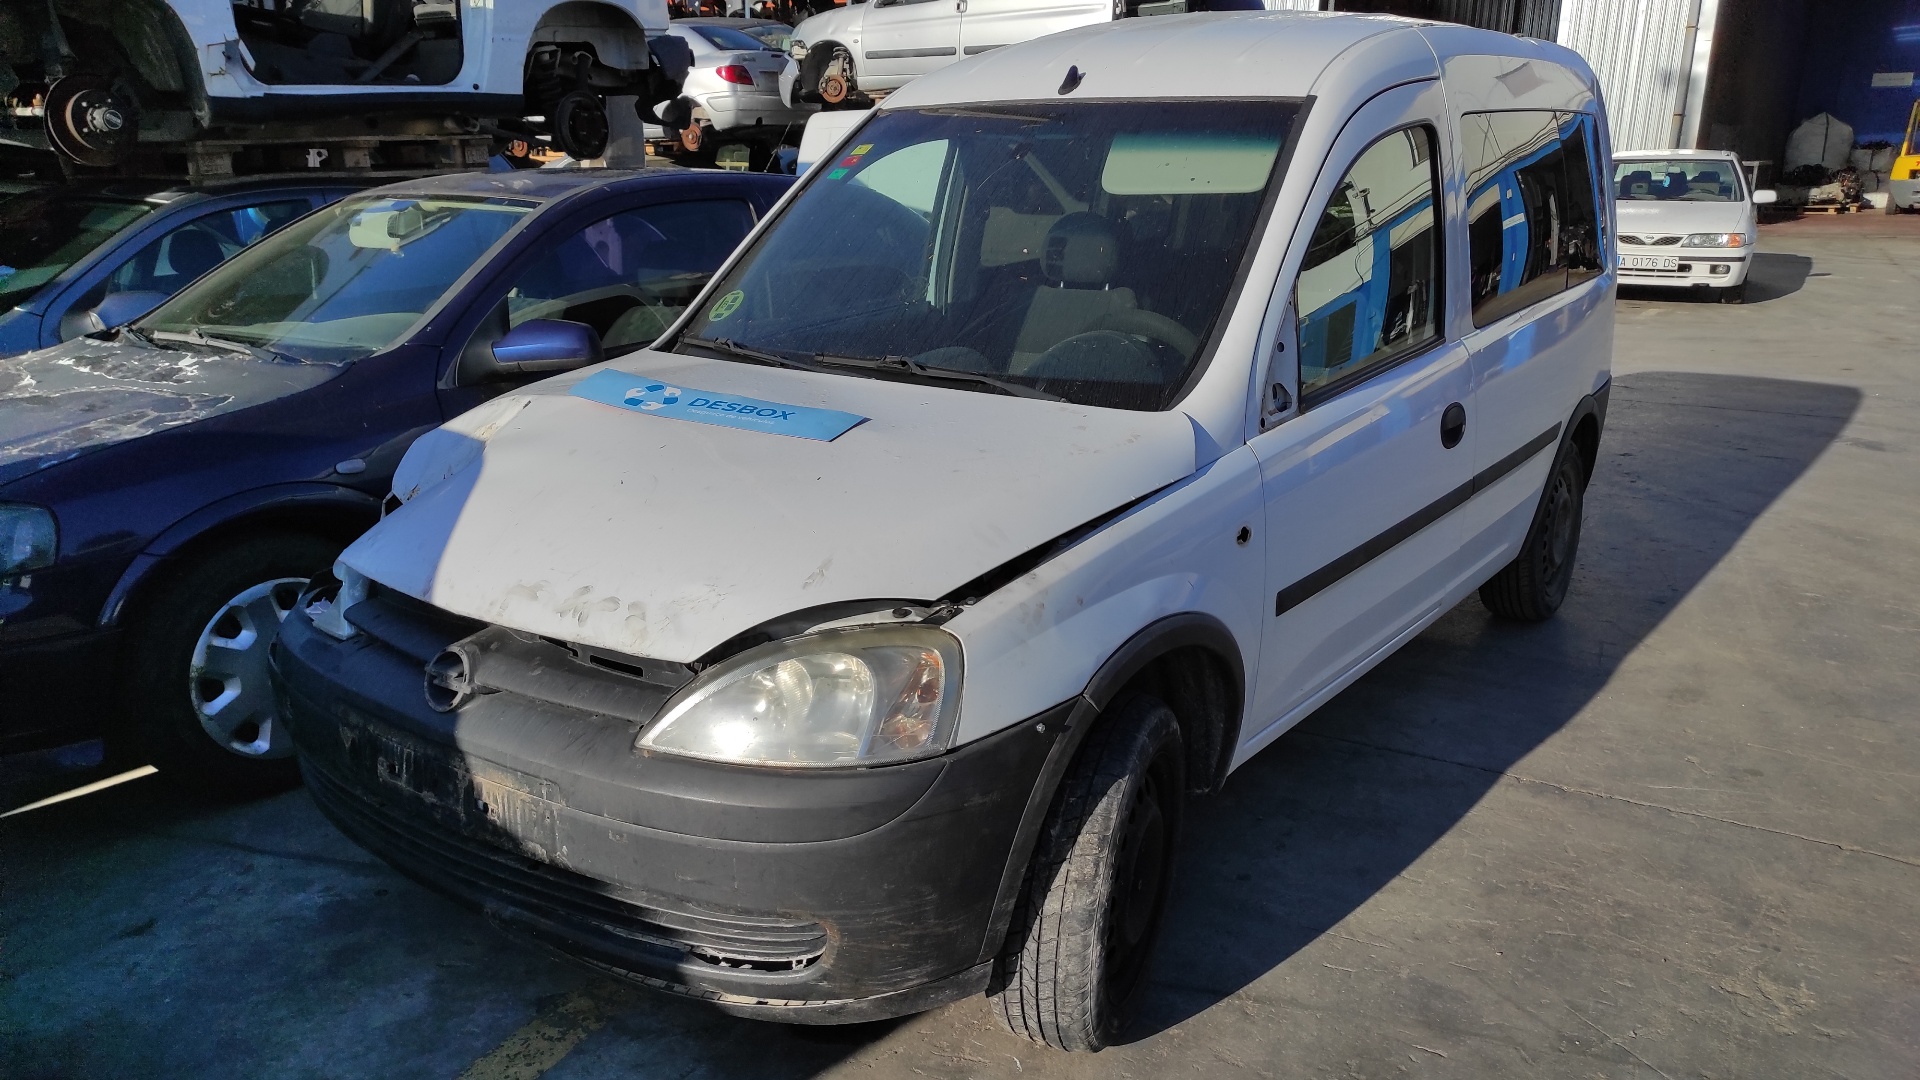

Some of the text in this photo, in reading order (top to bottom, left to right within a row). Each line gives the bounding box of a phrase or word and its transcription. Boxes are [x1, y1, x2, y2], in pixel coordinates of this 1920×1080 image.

[1632, 257, 1659, 268] 0176
[1663, 258, 1678, 268] DS
[687, 397, 796, 421] DESBOX
